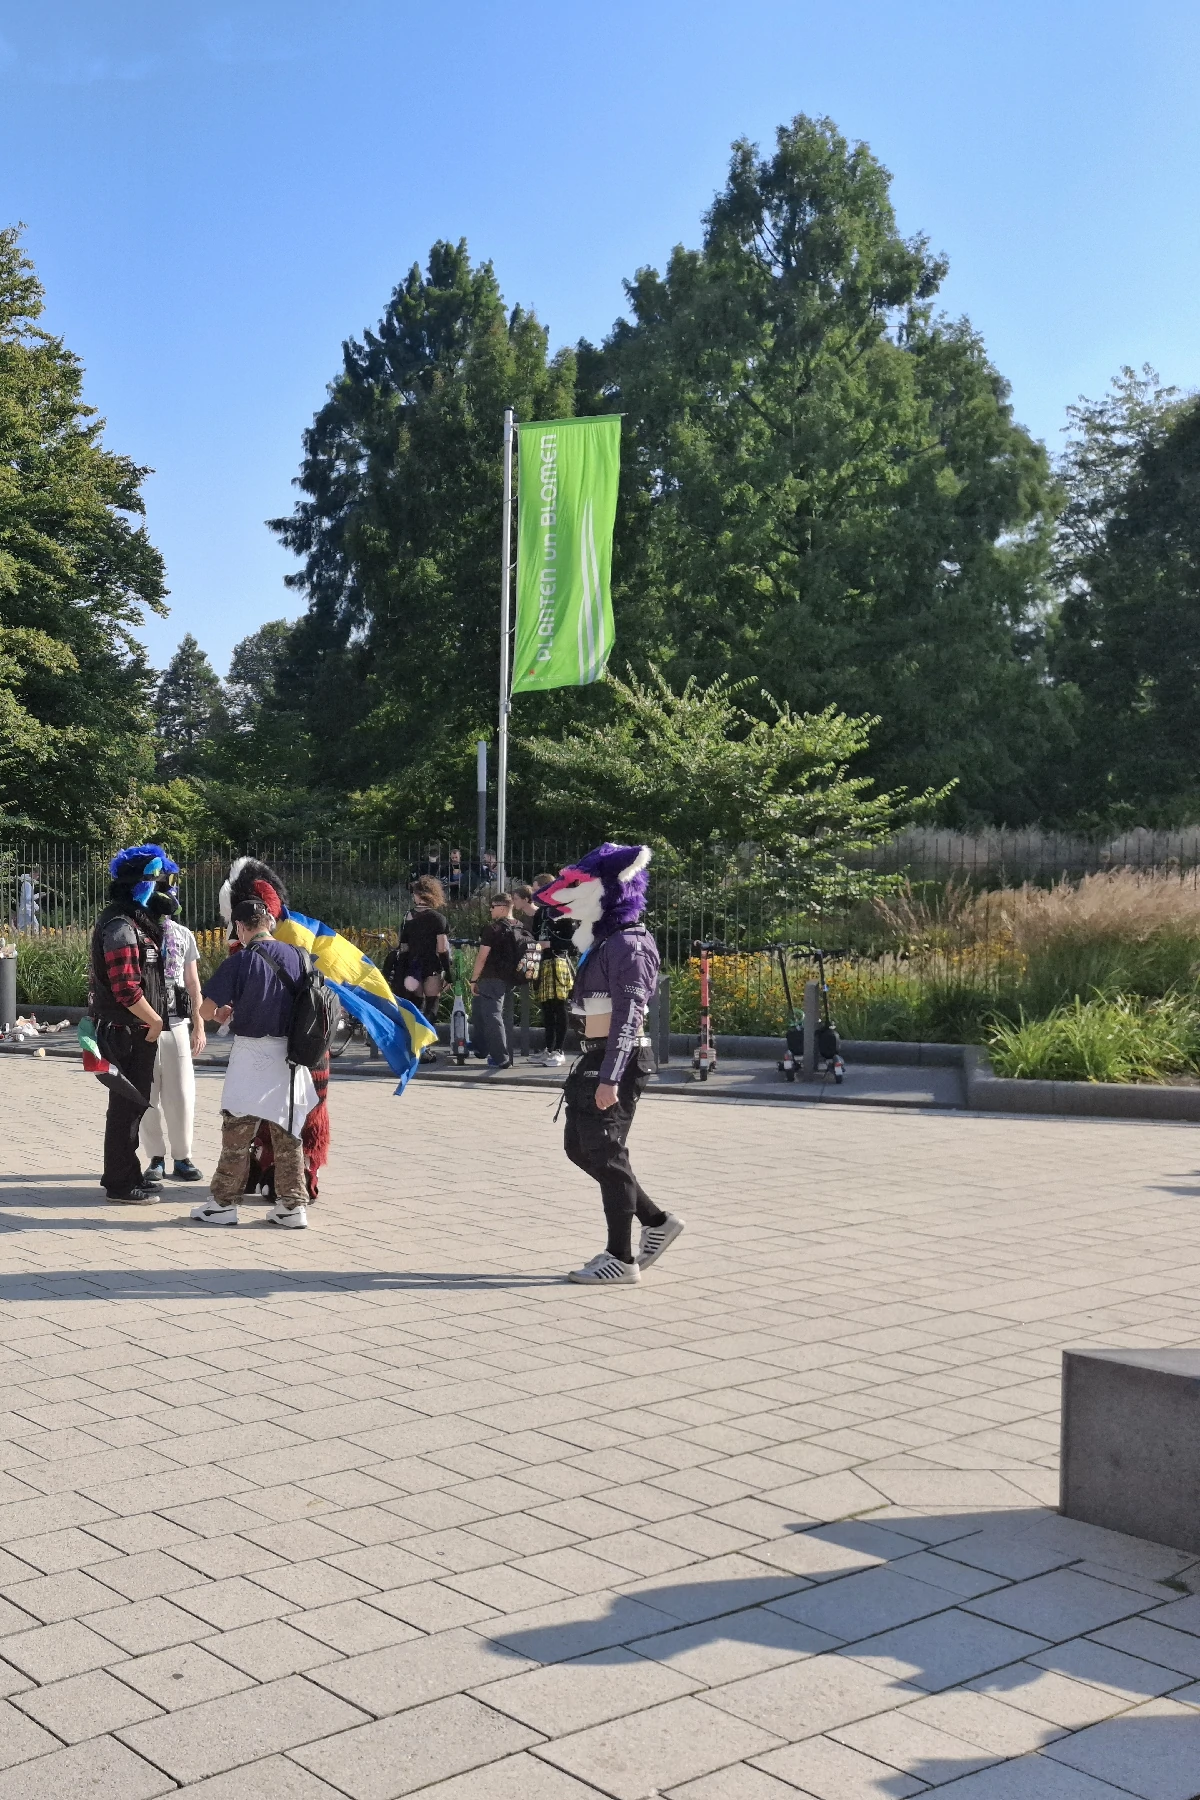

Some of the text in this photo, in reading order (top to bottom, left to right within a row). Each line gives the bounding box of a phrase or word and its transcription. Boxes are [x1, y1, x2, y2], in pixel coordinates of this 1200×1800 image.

[537, 434, 557, 662] PLANTEN un BLOMEN
